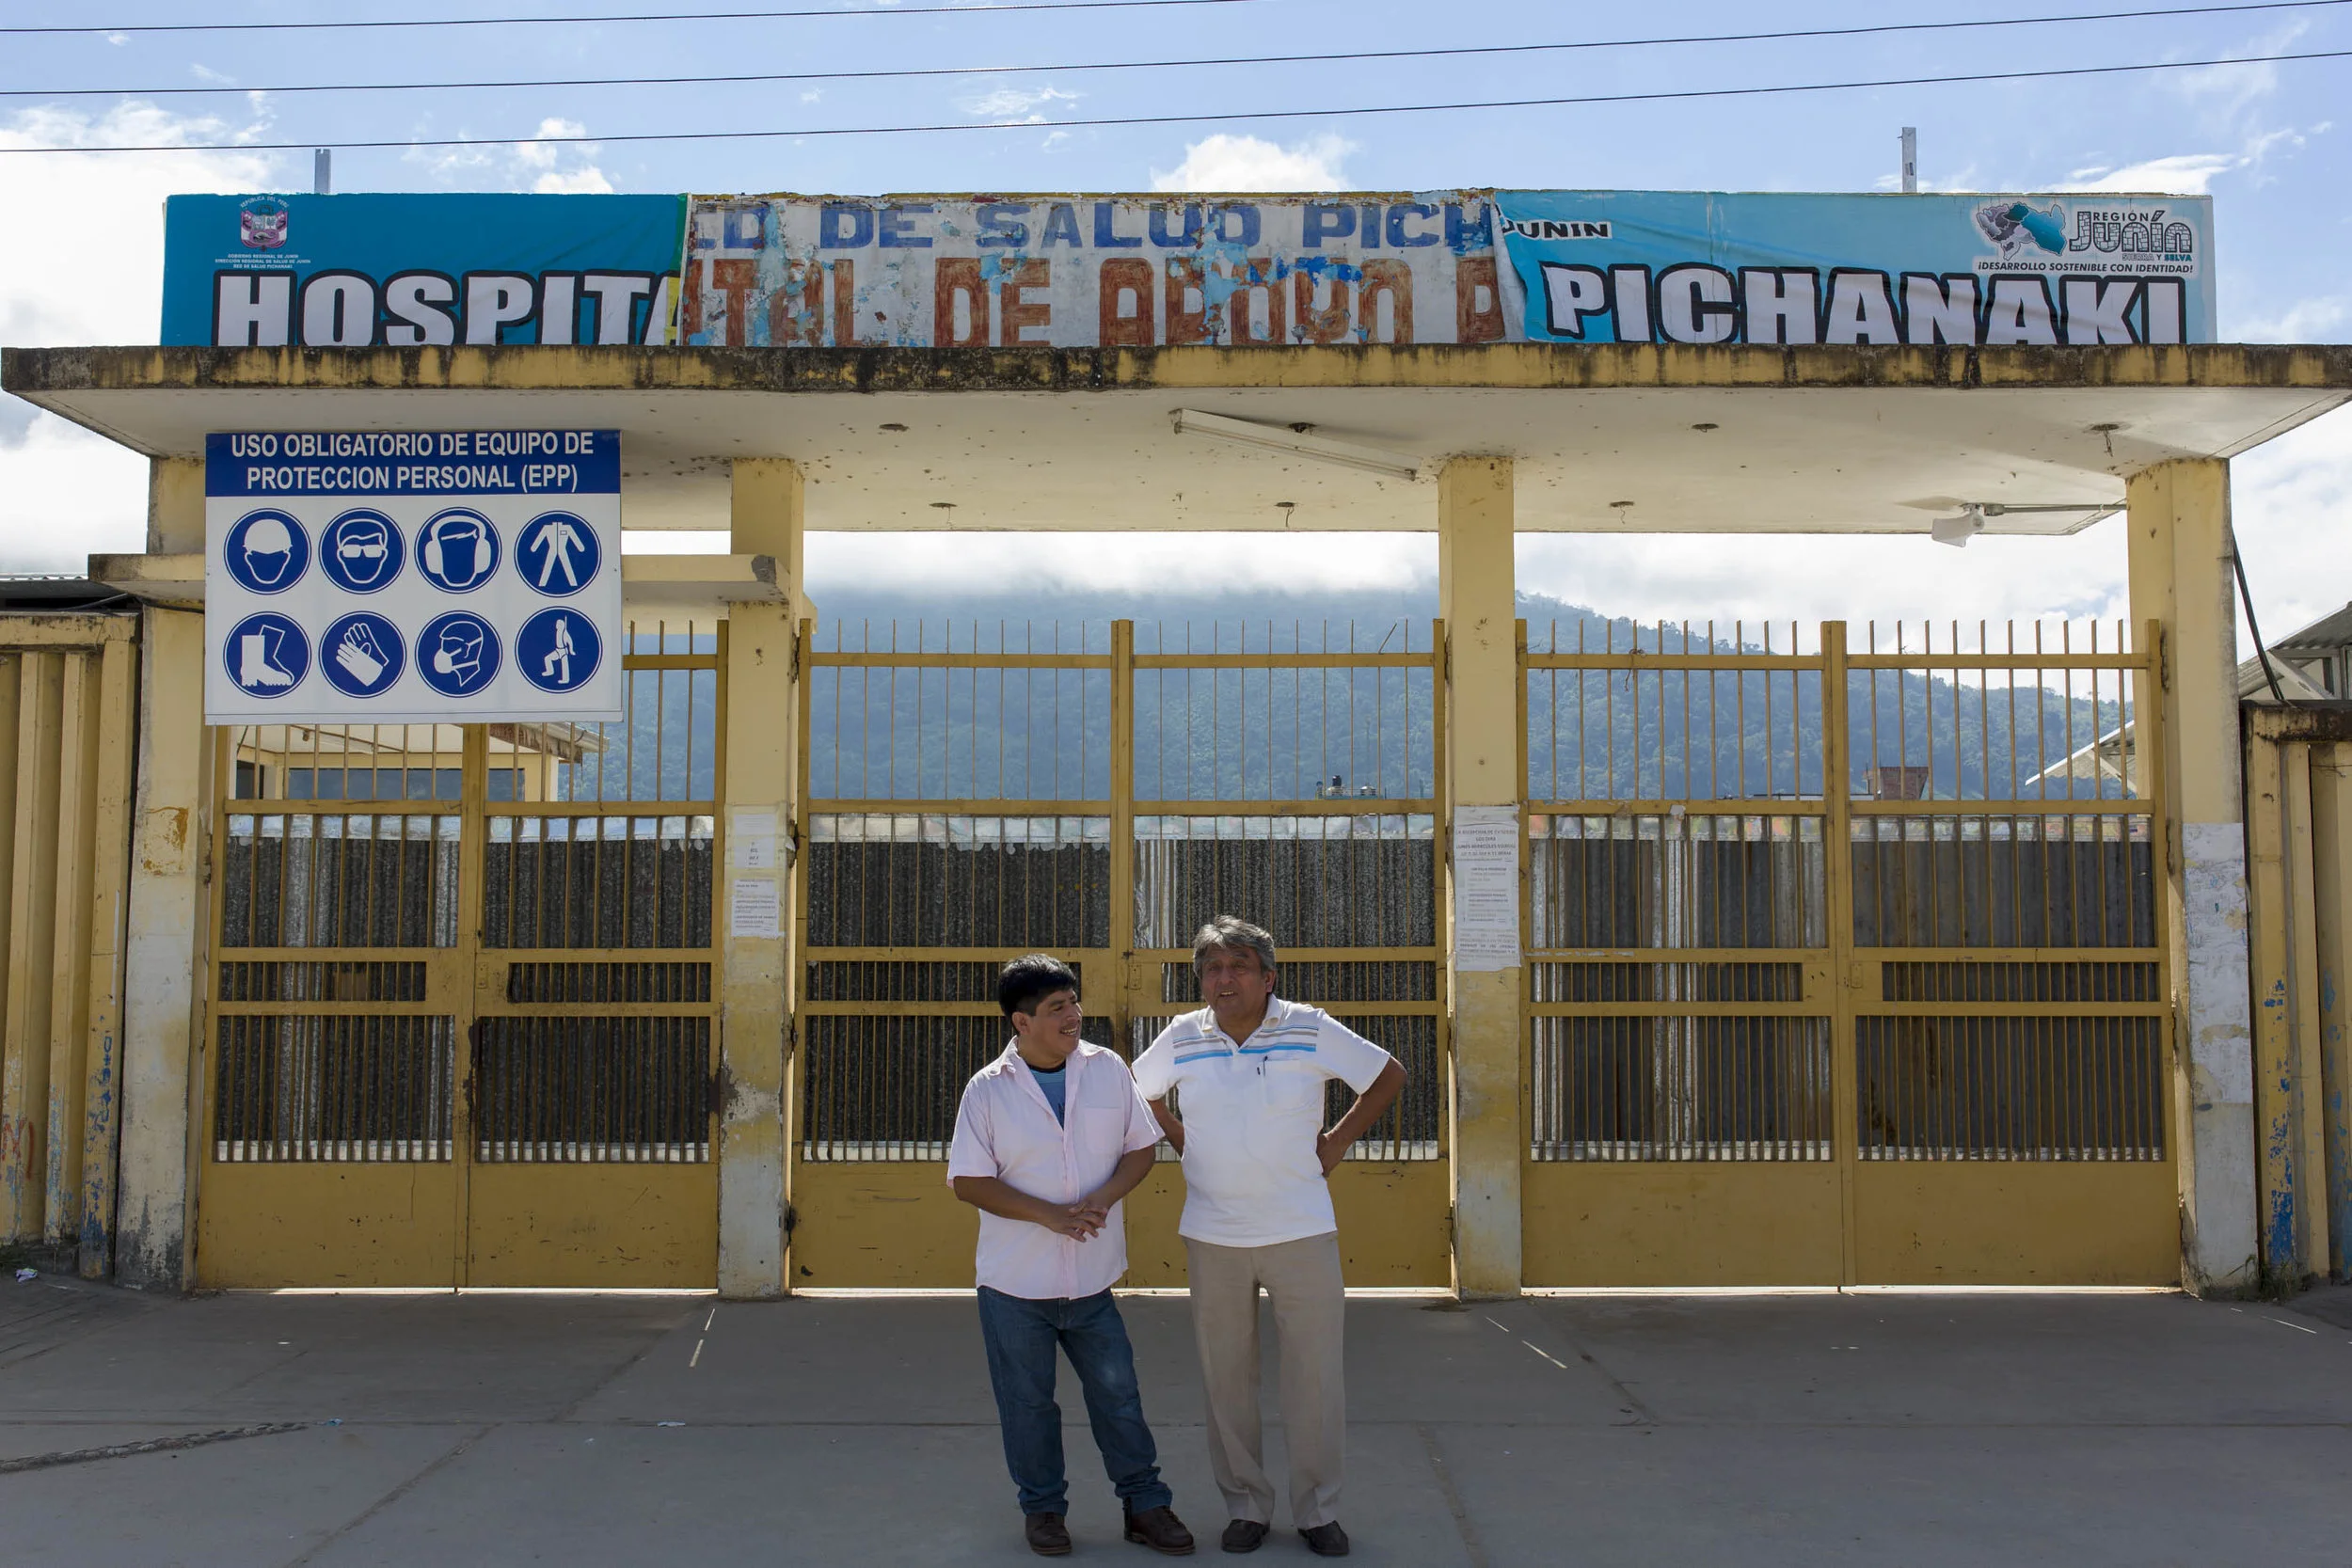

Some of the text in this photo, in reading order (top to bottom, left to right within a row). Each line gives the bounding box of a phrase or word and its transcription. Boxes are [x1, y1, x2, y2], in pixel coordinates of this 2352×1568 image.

[820, 202, 933, 248] DE
[975, 202, 1261, 248] SALUD
[1303, 202, 1493, 248] PICH
[2093, 210, 2149, 222] REGIÓN
[2049, 262, 2107, 271] SOSTENIBLE
[2109, 263, 2133, 272] CON
[2135, 263, 2193, 273] IDENTIDAD!
[934, 258, 1051, 347] DE
[1541, 264, 2185, 345] PICHANAKI
[231, 432, 594, 458] USO OBLIGATORIO DE EQUIPO DE
[246, 464, 578, 493] PROTECCION PERSONAL (EPP)
